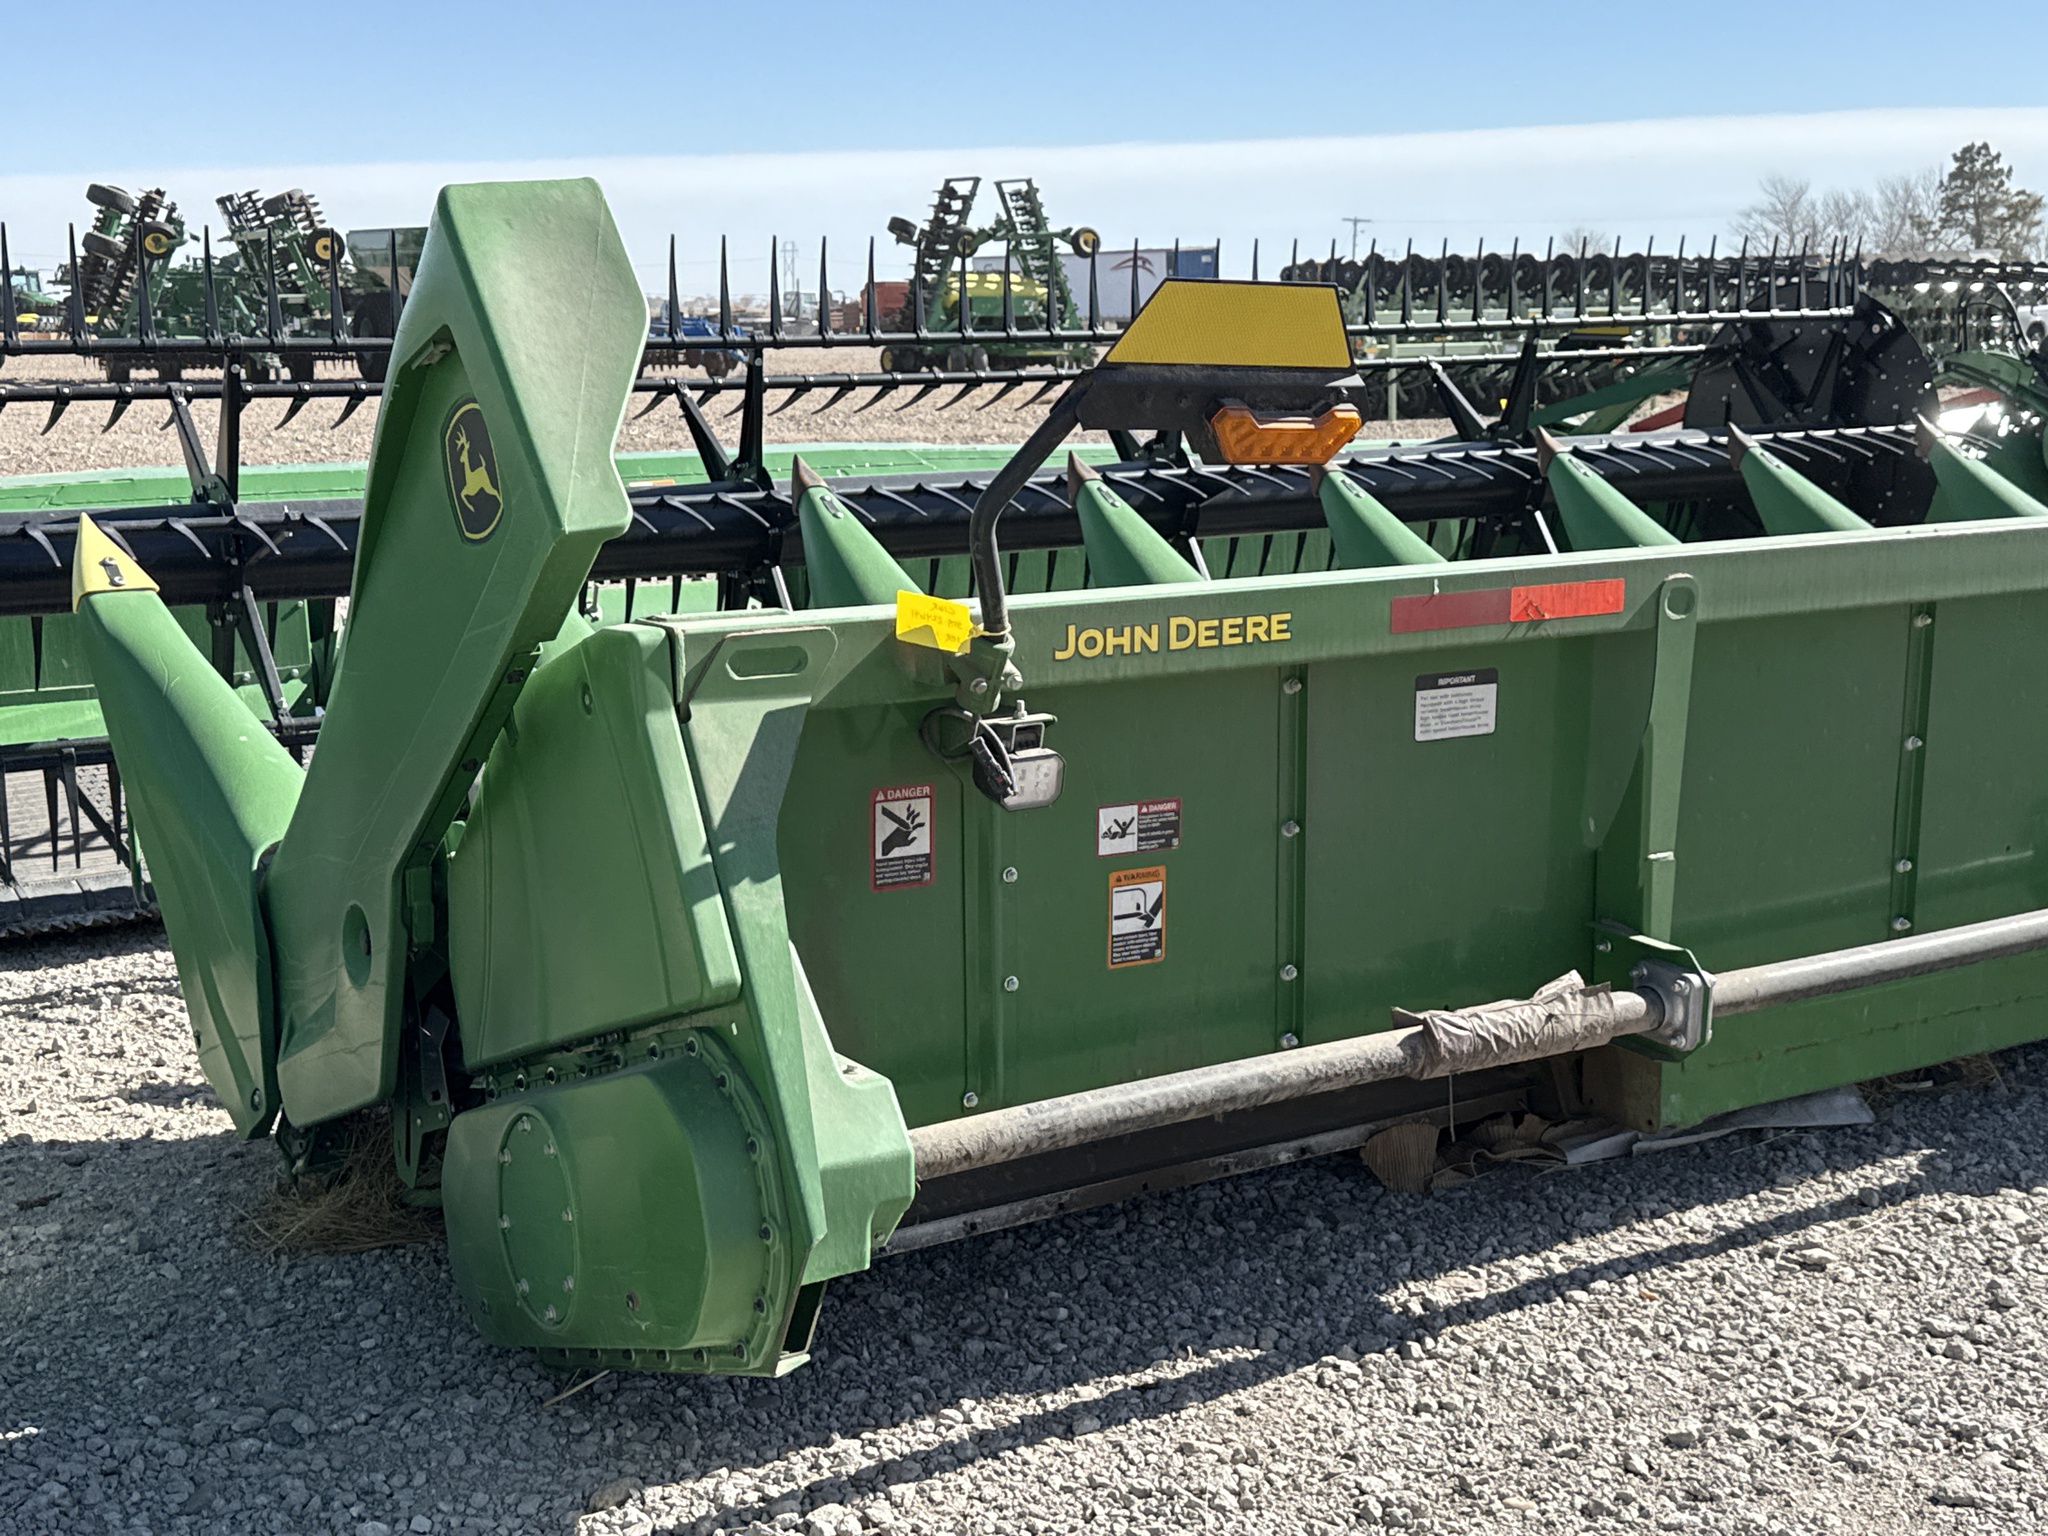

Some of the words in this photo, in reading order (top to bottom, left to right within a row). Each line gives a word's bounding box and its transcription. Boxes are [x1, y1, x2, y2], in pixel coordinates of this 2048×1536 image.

[1054, 623, 1160, 661] JOHN
[1168, 612, 1292, 651] DEERE
[1438, 674, 1476, 686] IMPORTANT
[887, 785, 931, 800] DANGER
[1148, 802, 1177, 813] DANGER
[1123, 869, 1161, 881] WARNING
